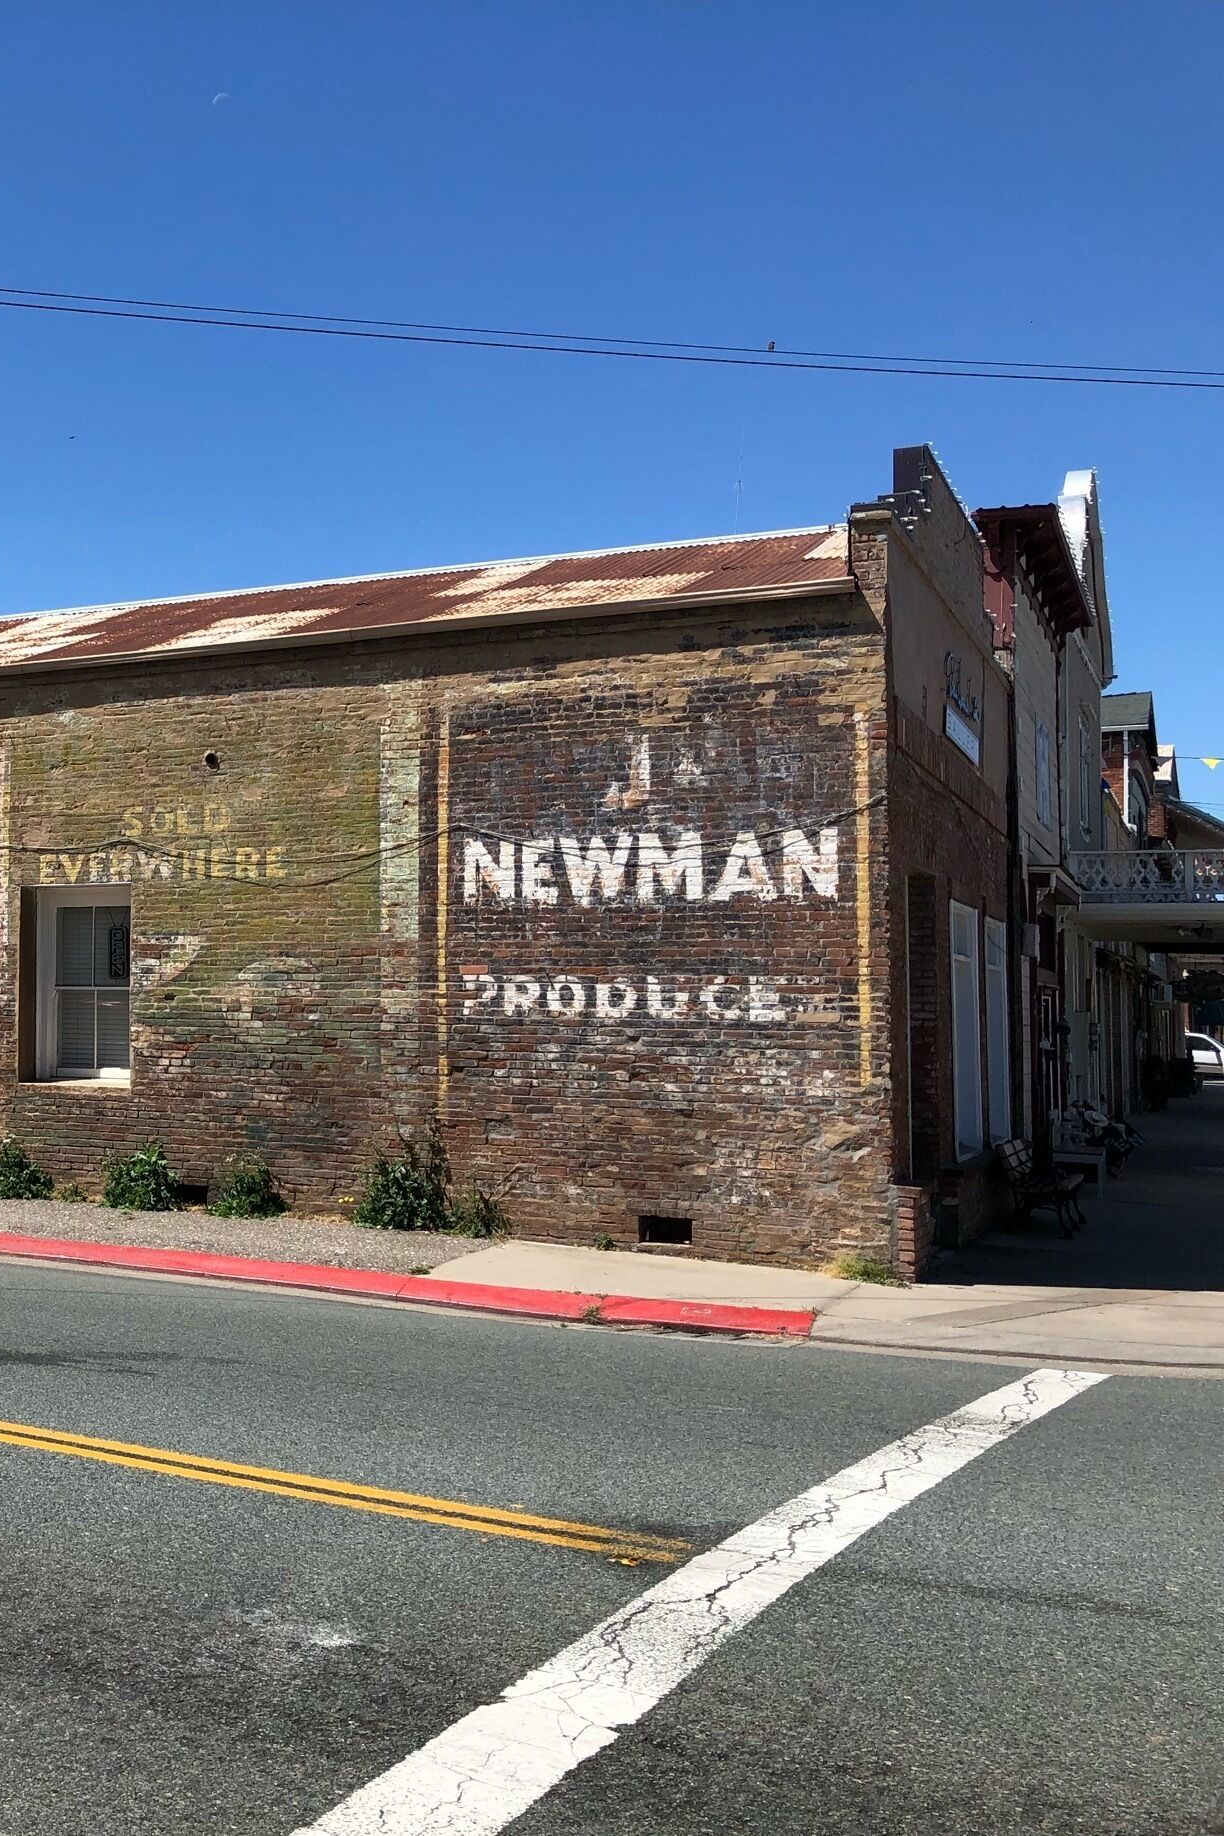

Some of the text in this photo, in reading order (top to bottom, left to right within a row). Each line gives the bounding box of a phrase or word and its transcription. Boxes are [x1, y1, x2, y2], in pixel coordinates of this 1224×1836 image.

[122, 803, 231, 838] SOLD
[39, 846, 288, 885] EVERYWHERE
[462, 827, 840, 908] NEWMAN
[111, 929, 124, 977] OPEN
[462, 973, 788, 1022] PRODUCE
